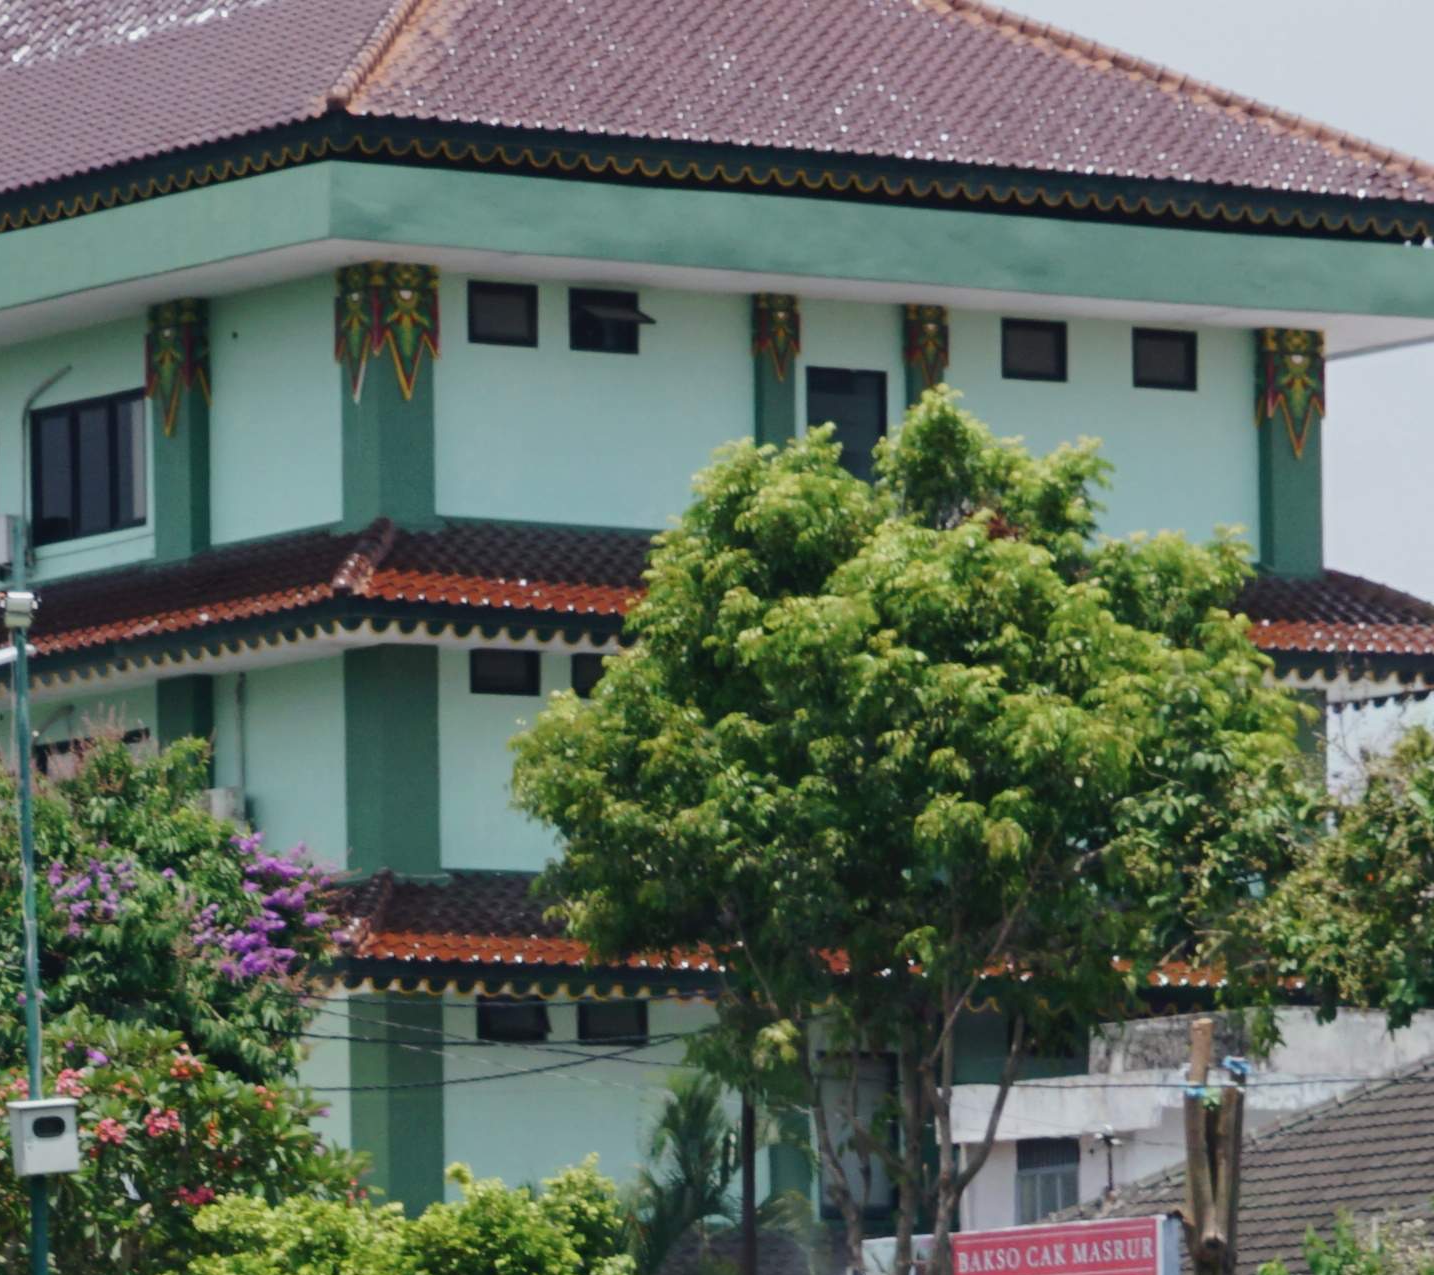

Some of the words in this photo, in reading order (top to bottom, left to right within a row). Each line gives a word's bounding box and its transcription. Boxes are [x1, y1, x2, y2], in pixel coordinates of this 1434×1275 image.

[958, 1249, 1021, 1273] BAKSO
[1025, 1243, 1066, 1267] CAK
[1071, 1237, 1154, 1263] MASRUR
